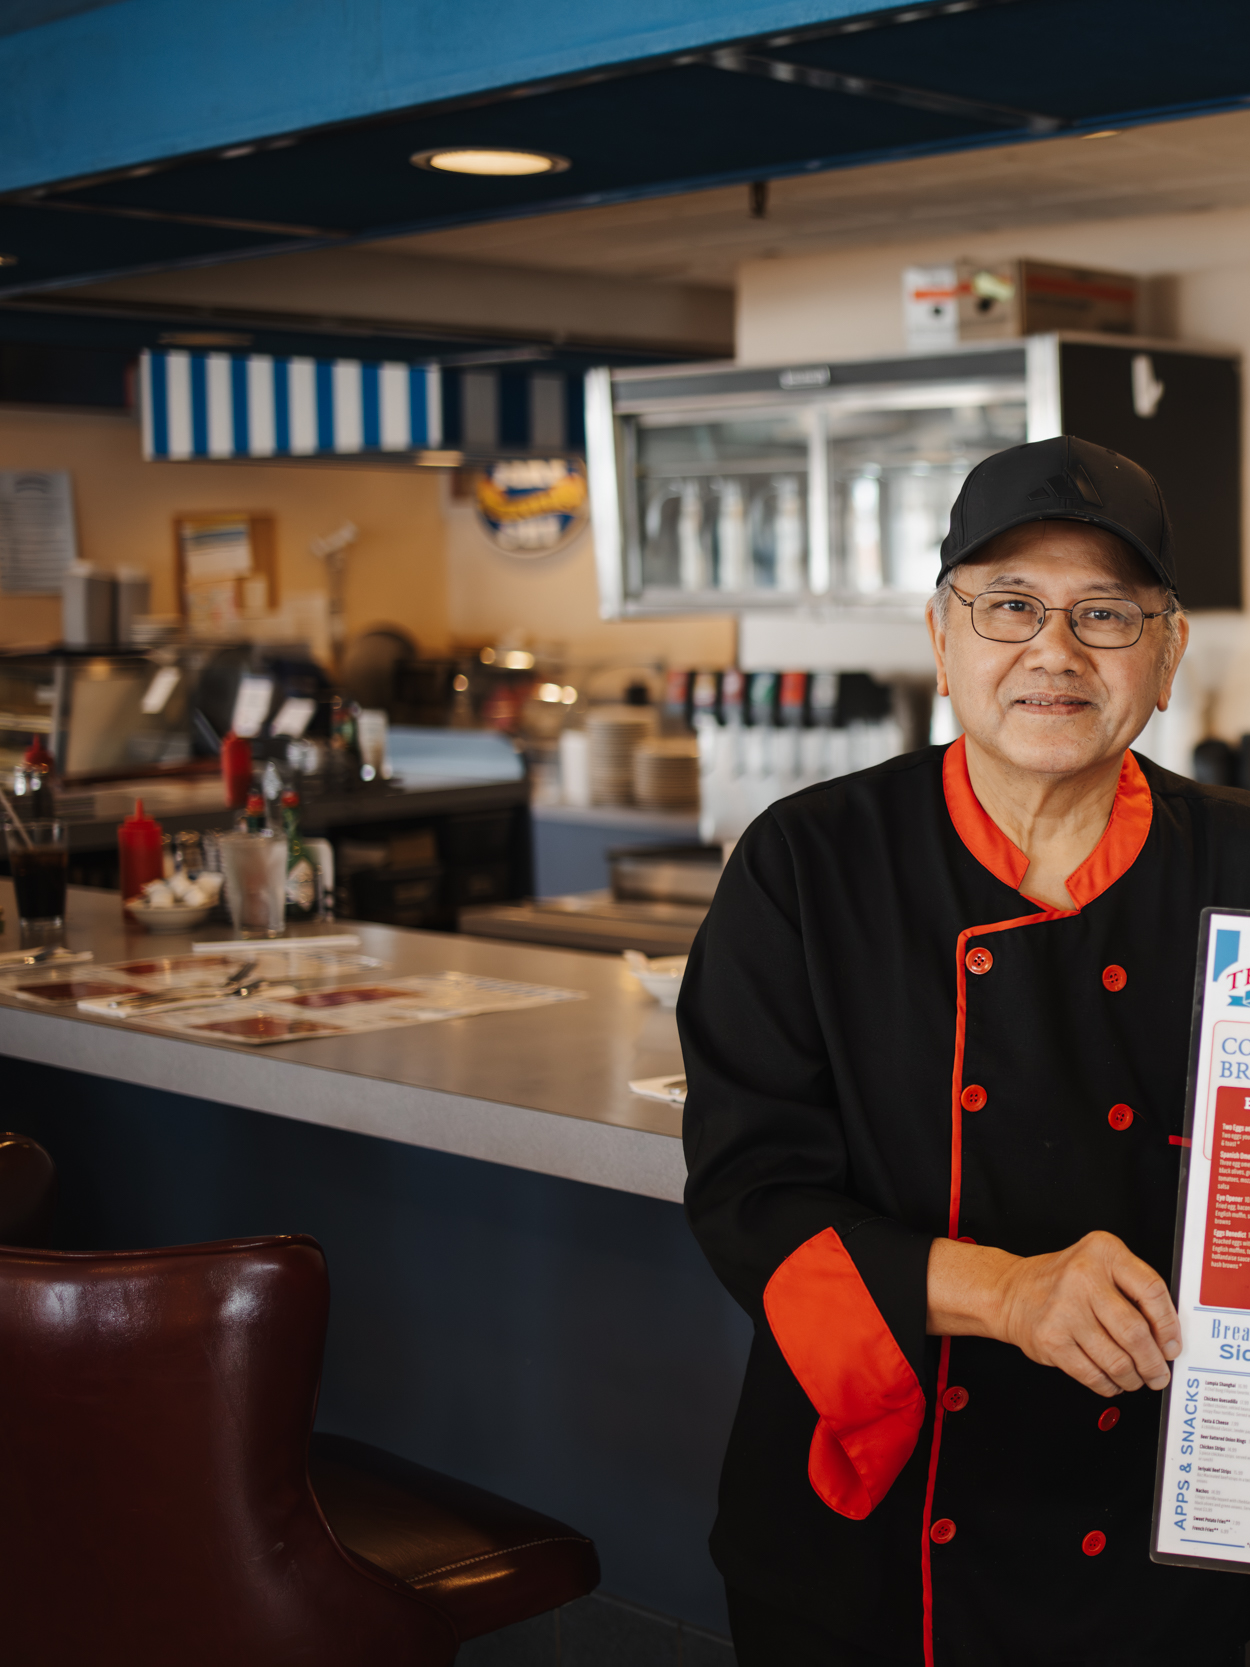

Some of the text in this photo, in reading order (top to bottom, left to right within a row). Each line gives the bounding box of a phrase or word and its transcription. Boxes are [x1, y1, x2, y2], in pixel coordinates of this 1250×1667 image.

[1173, 1377, 1200, 1531] APPS & SNACKS
